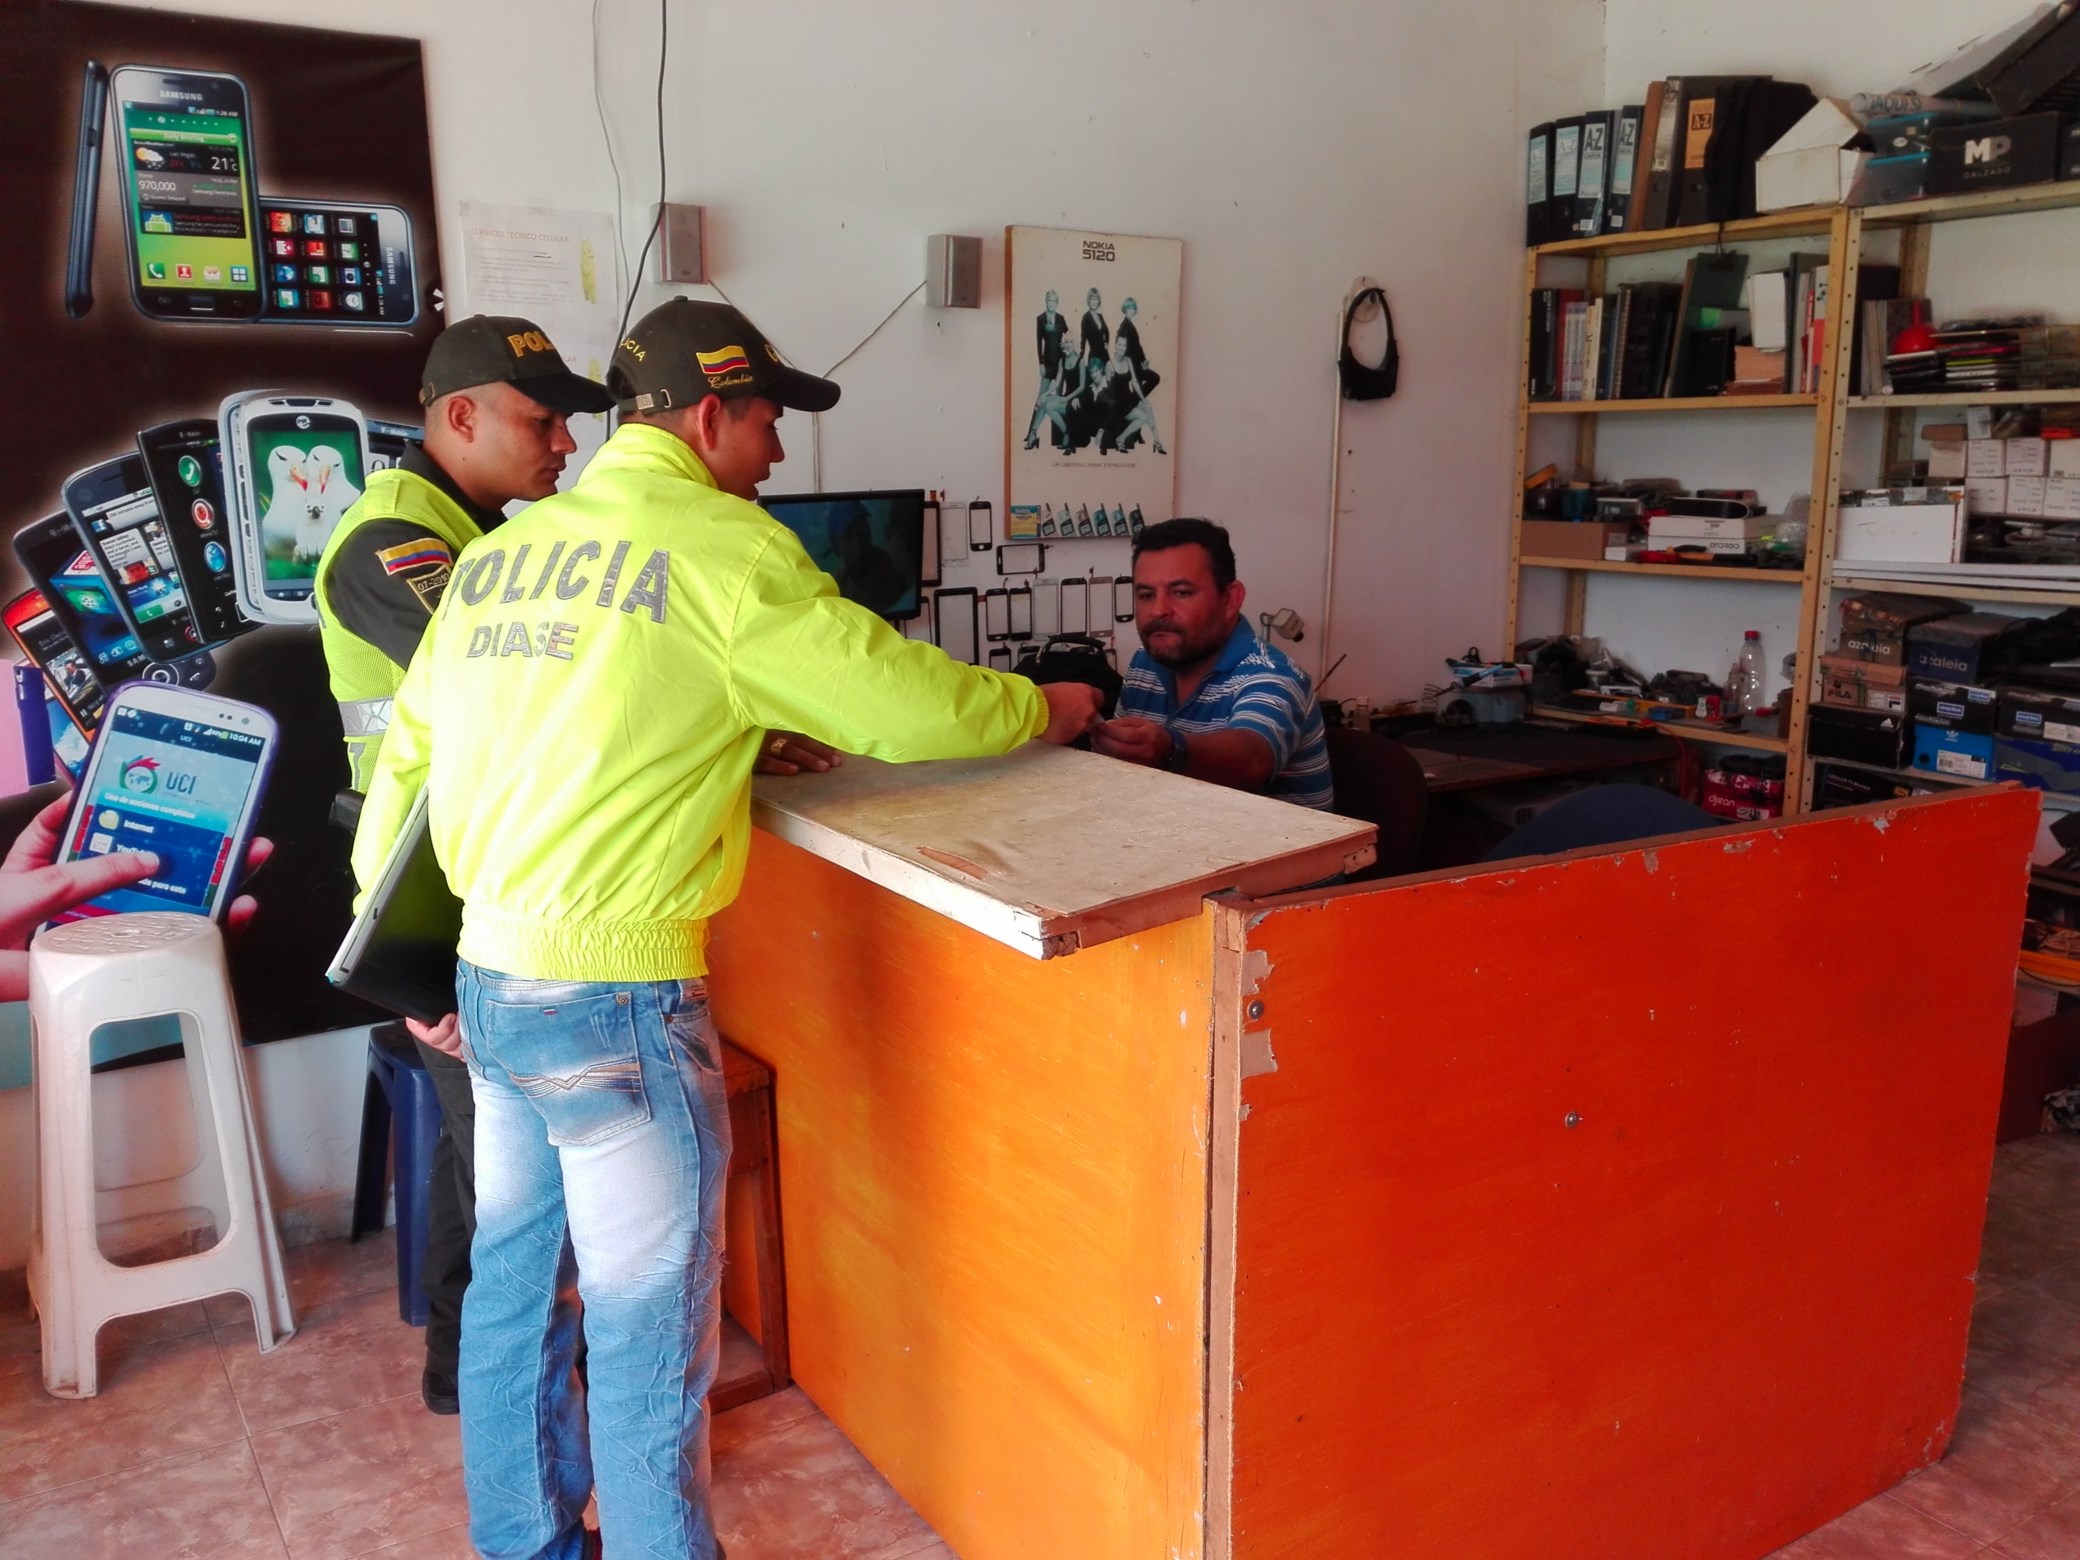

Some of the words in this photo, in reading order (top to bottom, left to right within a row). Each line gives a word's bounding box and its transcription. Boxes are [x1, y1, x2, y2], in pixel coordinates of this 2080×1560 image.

[159, 89, 203, 101] SAMSUNG
[1693, 114, 1711, 130] A-Z
[1584, 127, 1604, 151] A-Z
[1619, 122, 1636, 147] A-Z
[1964, 136, 2012, 166] MP
[1963, 166, 2012, 180] CALZADO
[138, 180, 176, 192] 970,000
[1082, 240, 1116, 251] NOKIA
[1082, 249, 1116, 262] 5120
[385, 246, 397, 285] SAMSUNG
[707, 374, 754, 389] Colombia
[466, 621, 579, 660] DIASE
[1828, 689, 1852, 700] FILA
[229, 732, 249, 744] 10:04
[248, 737, 262, 746] AM
[165, 770, 197, 795] UCI
[123, 819, 155, 834] Internet
